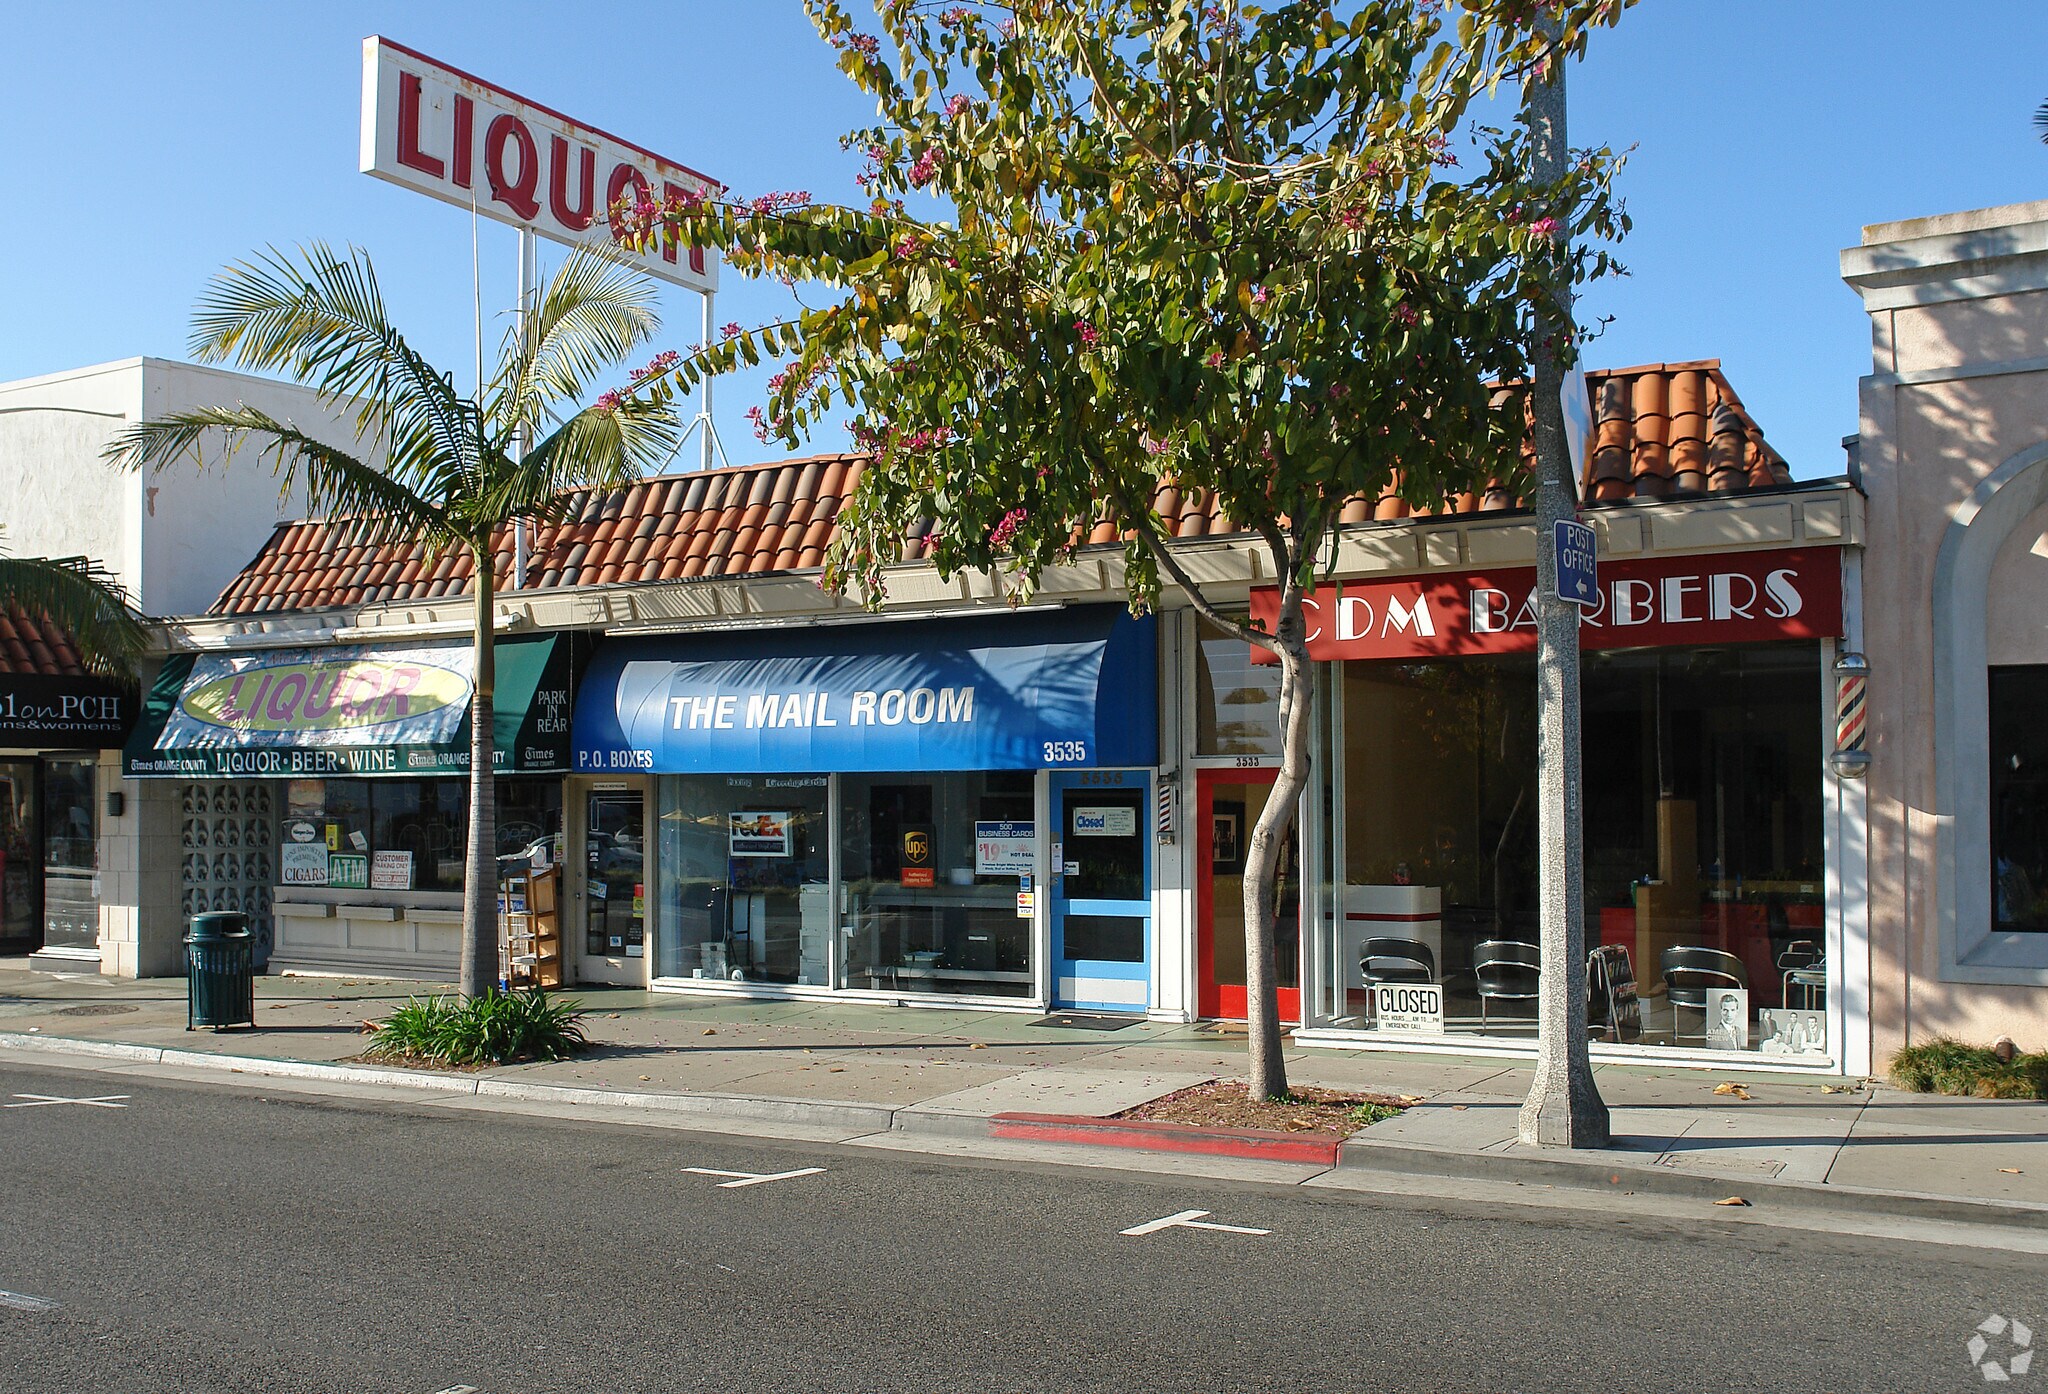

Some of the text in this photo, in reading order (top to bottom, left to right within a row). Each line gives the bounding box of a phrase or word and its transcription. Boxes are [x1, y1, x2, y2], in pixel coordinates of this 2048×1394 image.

[397, 70, 706, 276] LIQUOR
[1567, 525, 1590, 551] POST
[1563, 547, 1594, 574] OFFICE
[219, 668, 422, 724] LIQUOR
[537, 690, 567, 705] PARK
[59, 695, 121, 720] PCH
[546, 704, 558, 718] IN
[670, 687, 975, 730] THE MAIL ROOM
[0, 720, 121, 731] ns&womens
[537, 718, 567, 733] REAR
[408, 752, 470, 766] Times ORANGE
[525, 746, 554, 760] Times
[579, 749, 653, 768] P.O. BOXES
[1043, 741, 1086, 762] 3535
[131, 759, 207, 771] Times ORANGE COUNTY
[216, 750, 396, 772] LIQUOR BEER WINE
[1236, 757, 1260, 767] 3533
[1077, 815, 1105, 828] Closed
[376, 854, 409, 862] CUSTOMER
[906, 841, 926, 858] ups
[285, 867, 326, 881] CIGARS
[331, 858, 365, 884] ATM
[1380, 988, 1439, 1014] CLOSED
